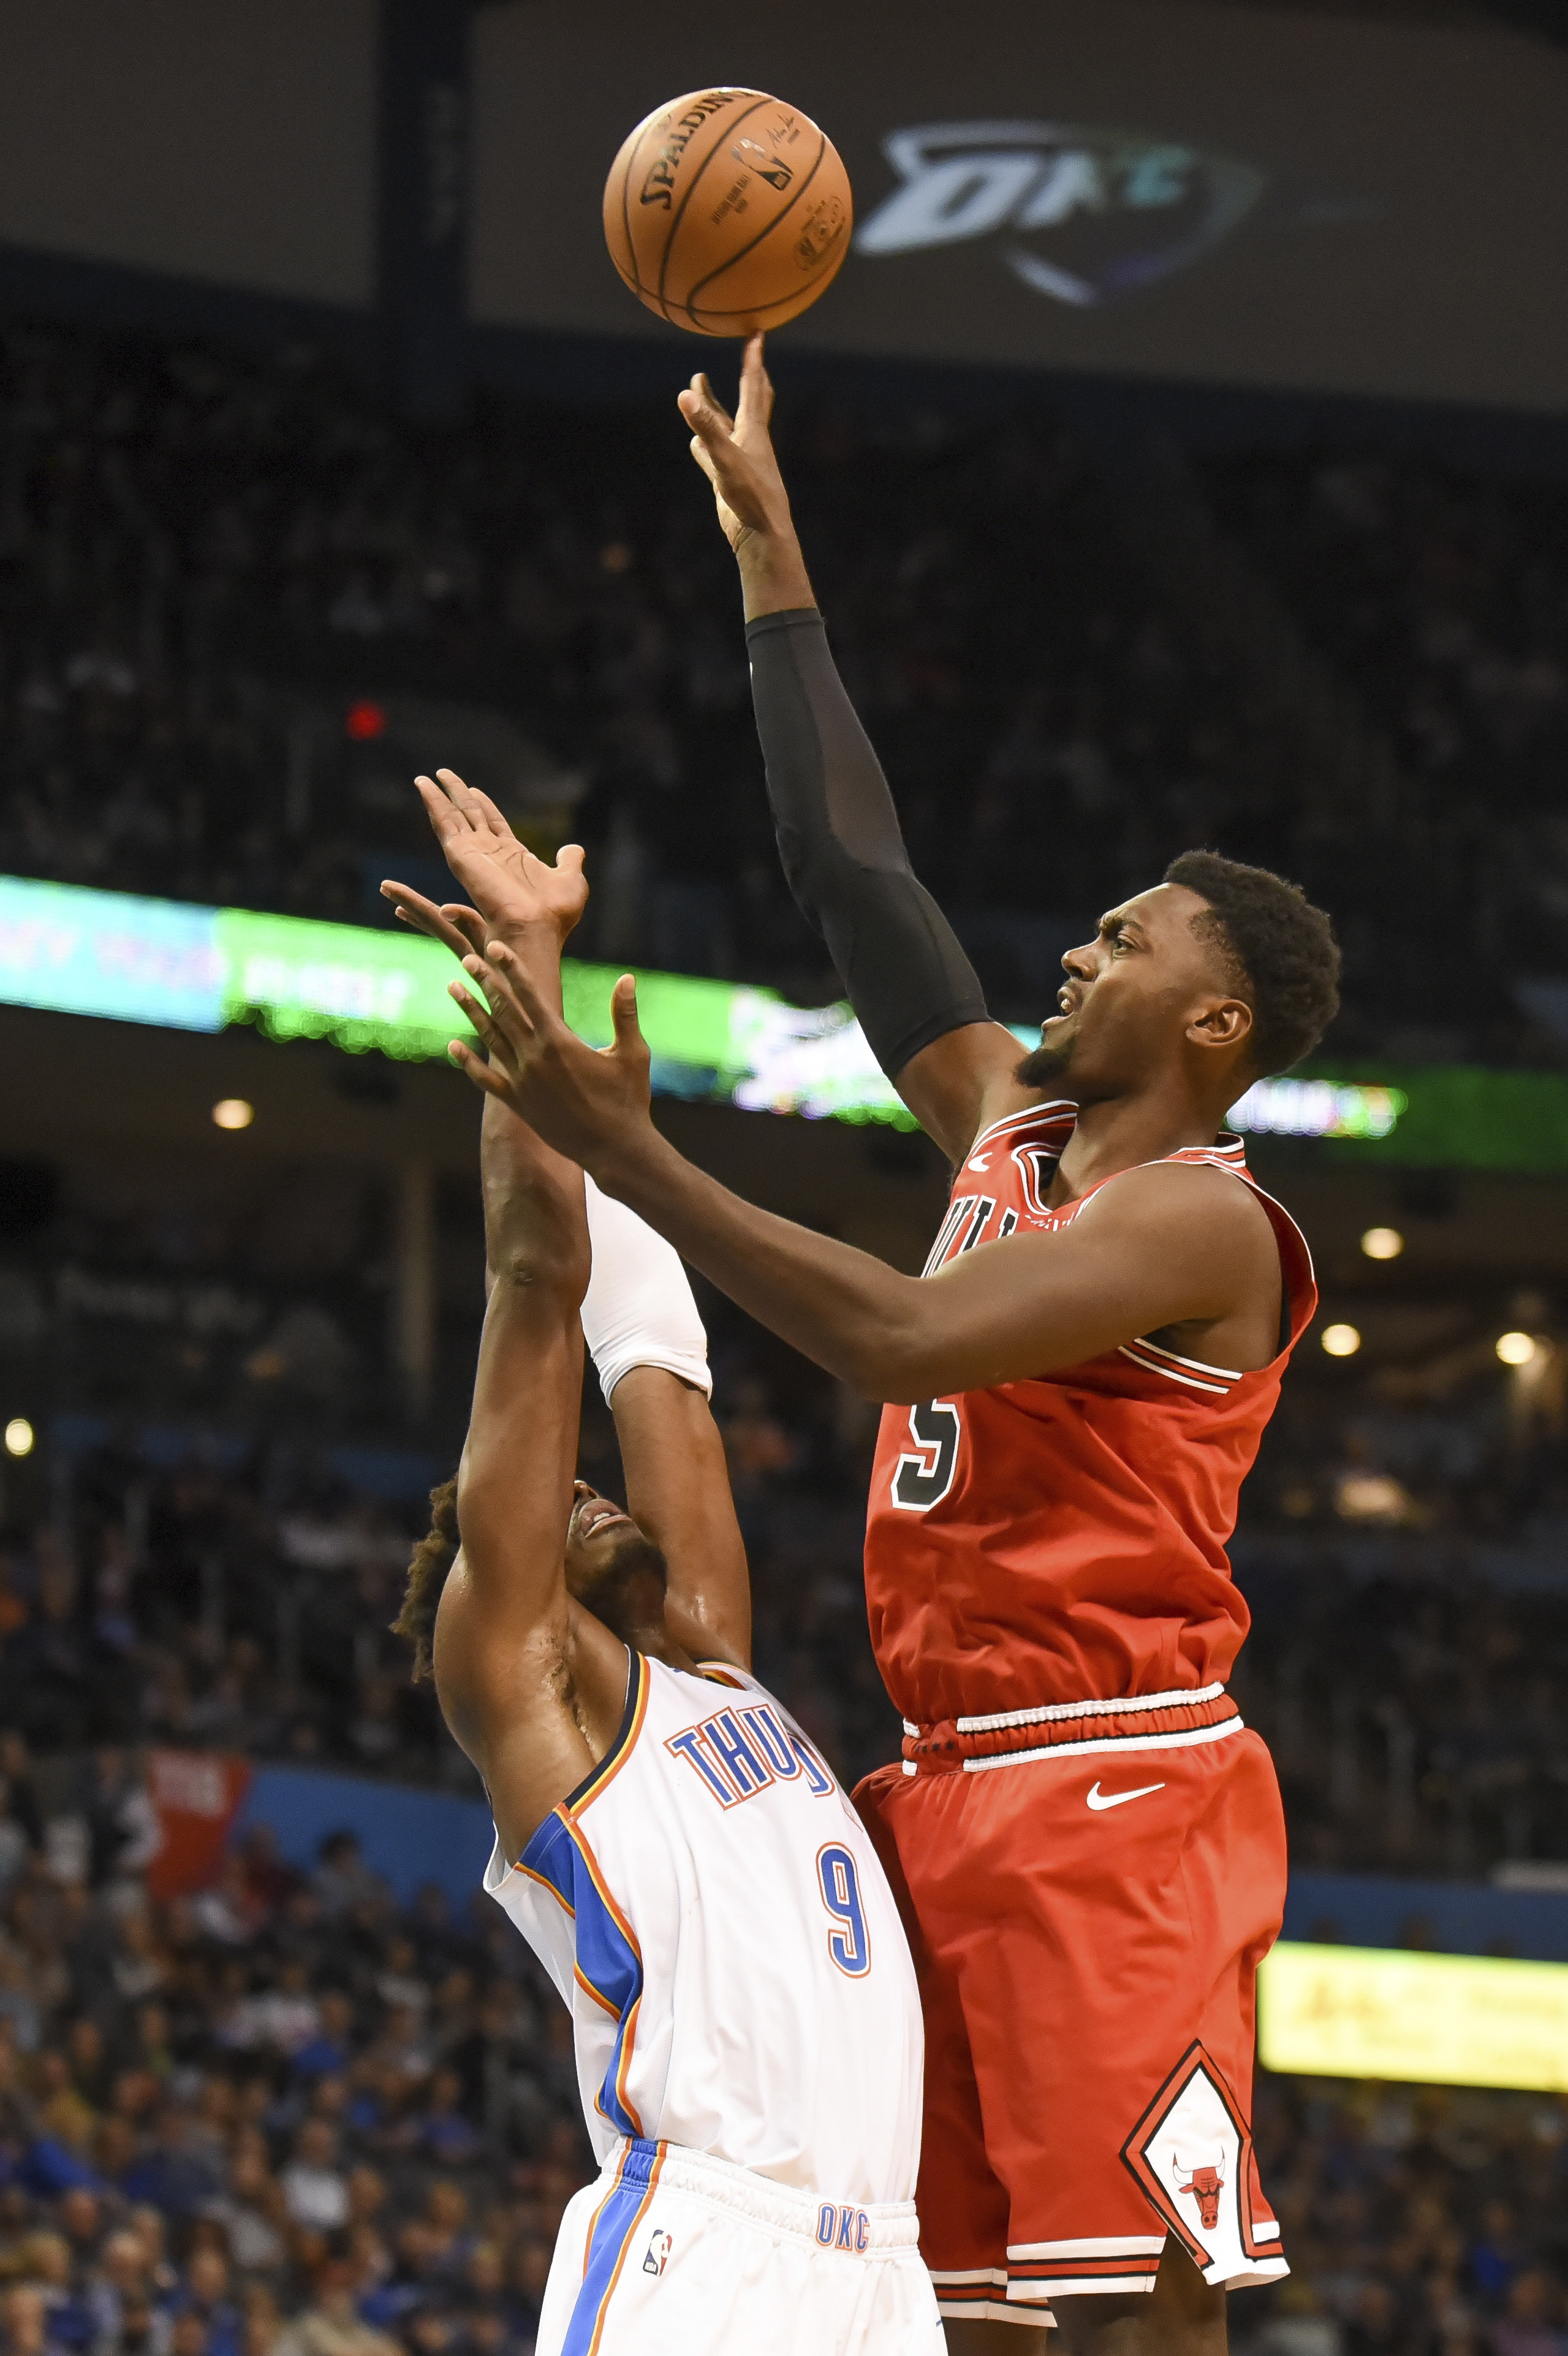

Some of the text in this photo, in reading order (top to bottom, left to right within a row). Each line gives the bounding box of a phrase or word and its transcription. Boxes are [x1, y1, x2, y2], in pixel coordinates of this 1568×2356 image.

[890, 1398, 961, 1512] 5
[816, 1841, 871, 1979] 9
[816, 2202, 870, 2253] OKC
